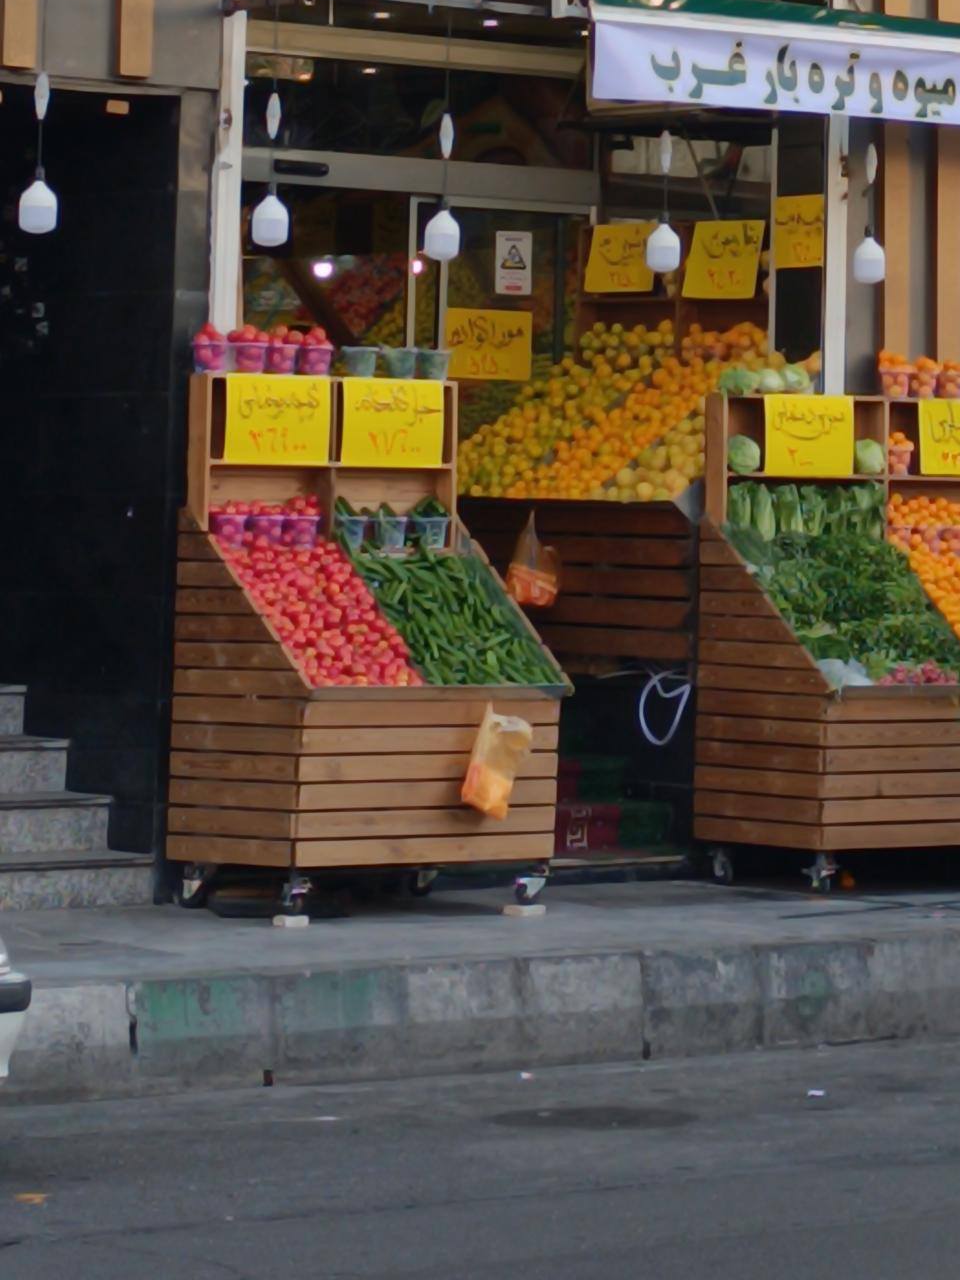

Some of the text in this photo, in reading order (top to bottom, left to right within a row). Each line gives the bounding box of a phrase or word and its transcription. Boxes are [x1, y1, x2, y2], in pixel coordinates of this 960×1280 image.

[651, 40, 746, 99] غرب
[763, 44, 800, 104] بار
[808, 51, 861, 110] تره
[868, 71, 884, 113] و
[893, 69, 957, 118] میوه
